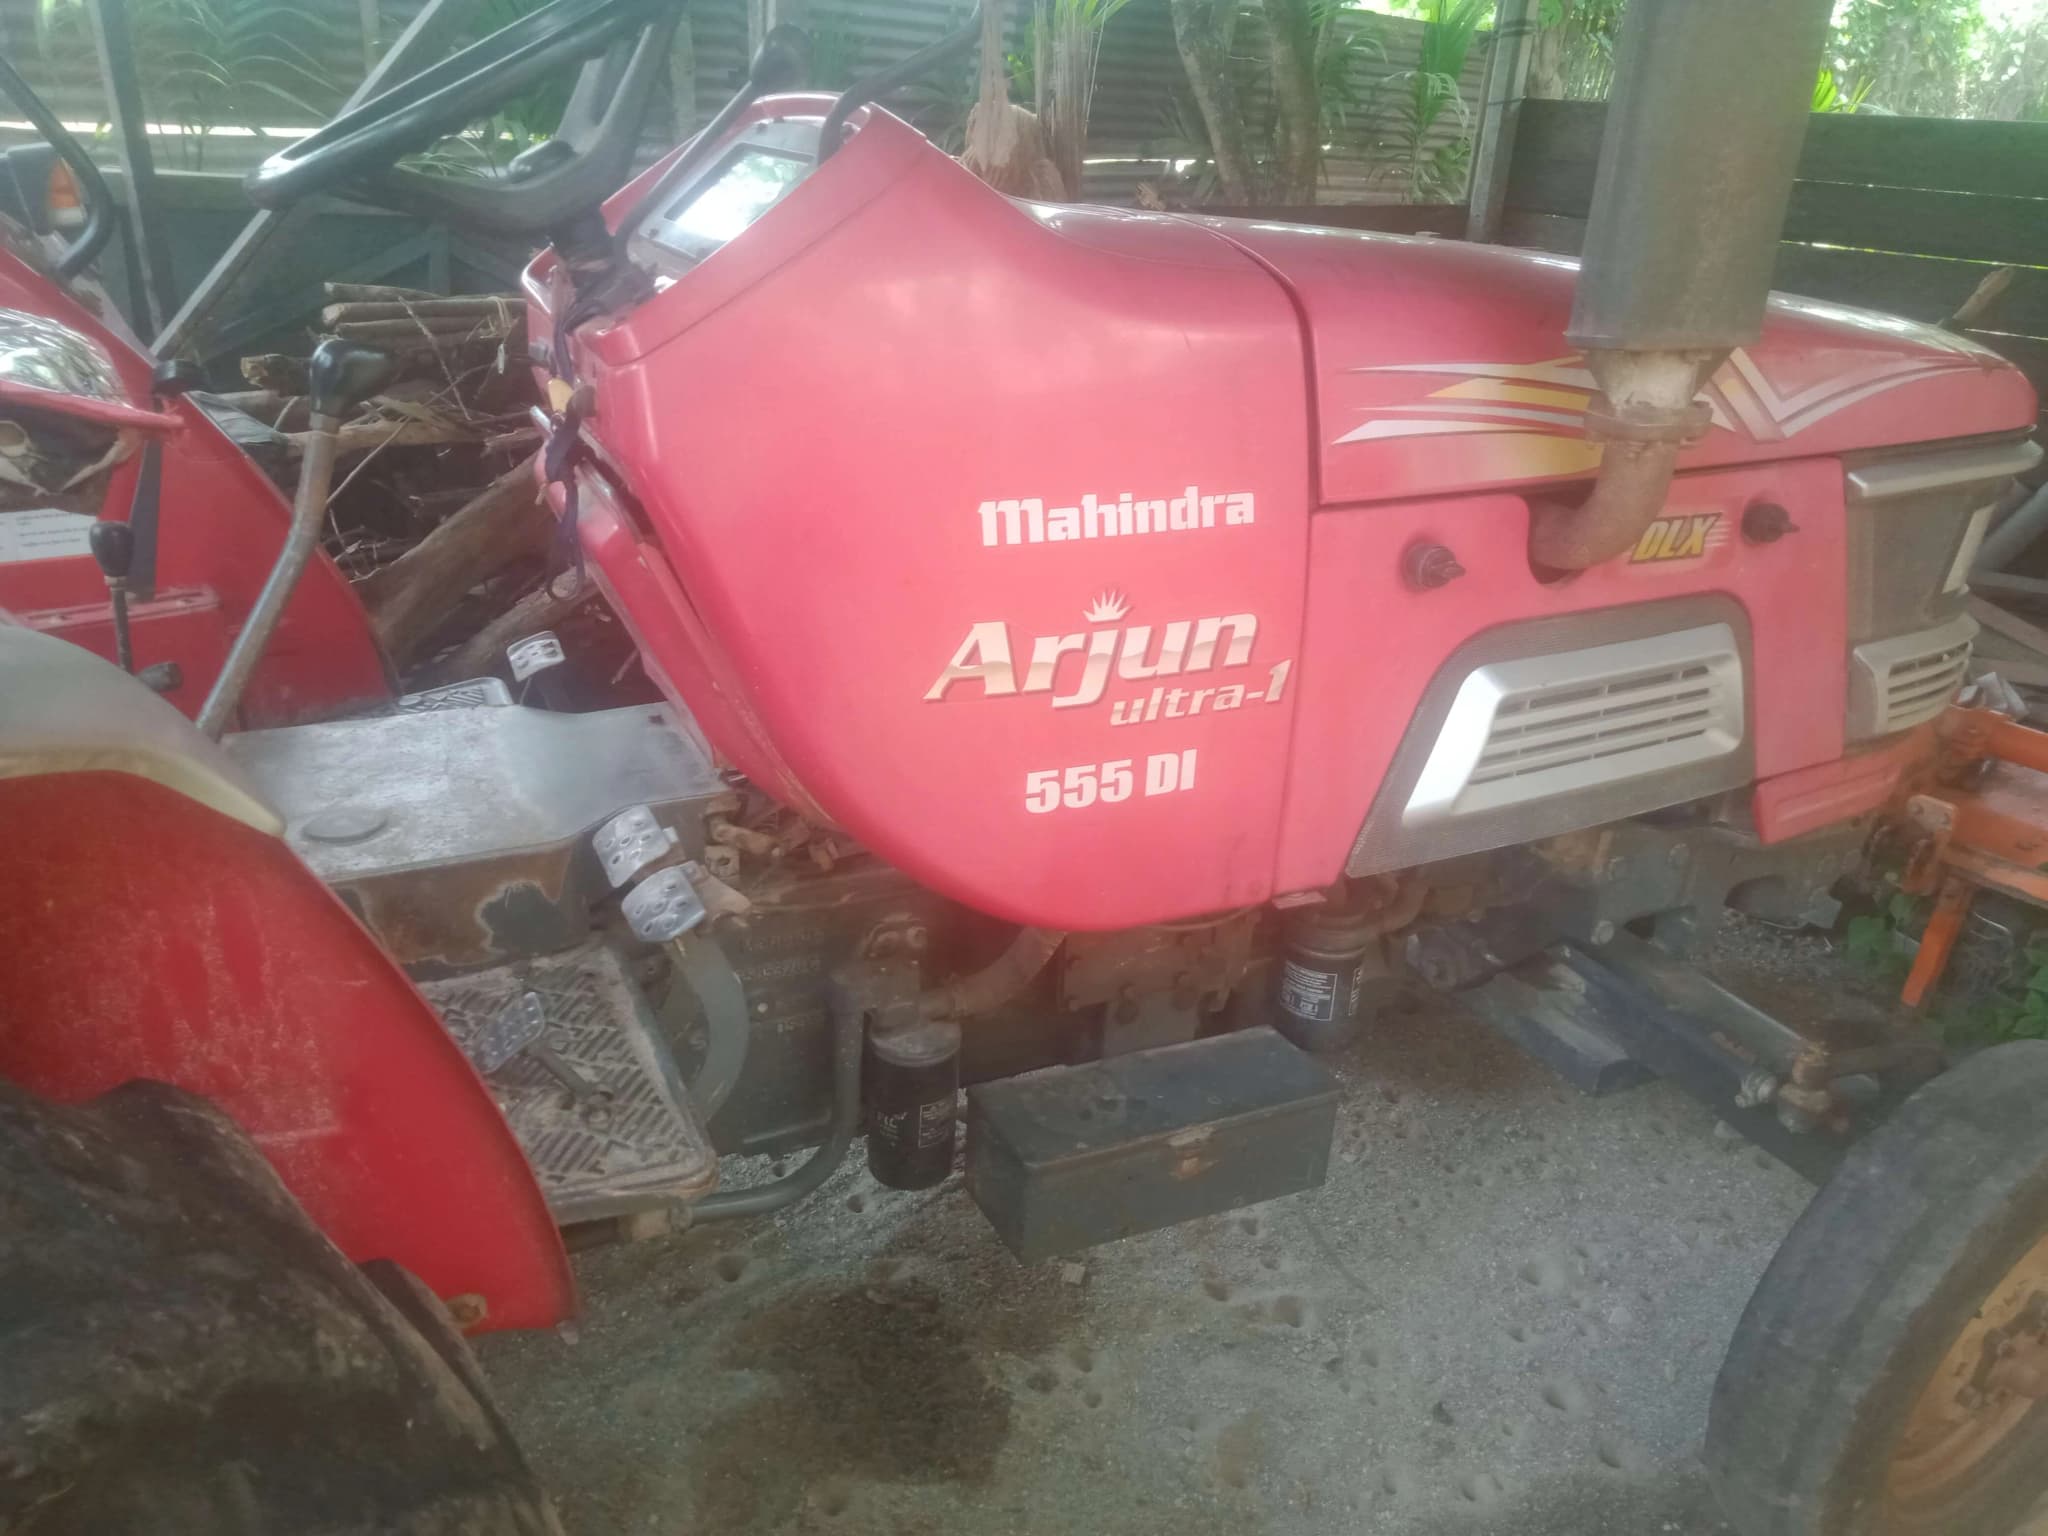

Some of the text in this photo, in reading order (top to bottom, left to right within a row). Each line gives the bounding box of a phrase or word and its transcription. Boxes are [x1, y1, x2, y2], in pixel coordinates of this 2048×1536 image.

[978, 486, 1255, 546] Mahindra
[1631, 515, 1718, 562] DLX
[922, 592, 1258, 708] Arjun
[1109, 659, 1293, 726] ultra-1
[1025, 749, 1197, 814] 555 DI
